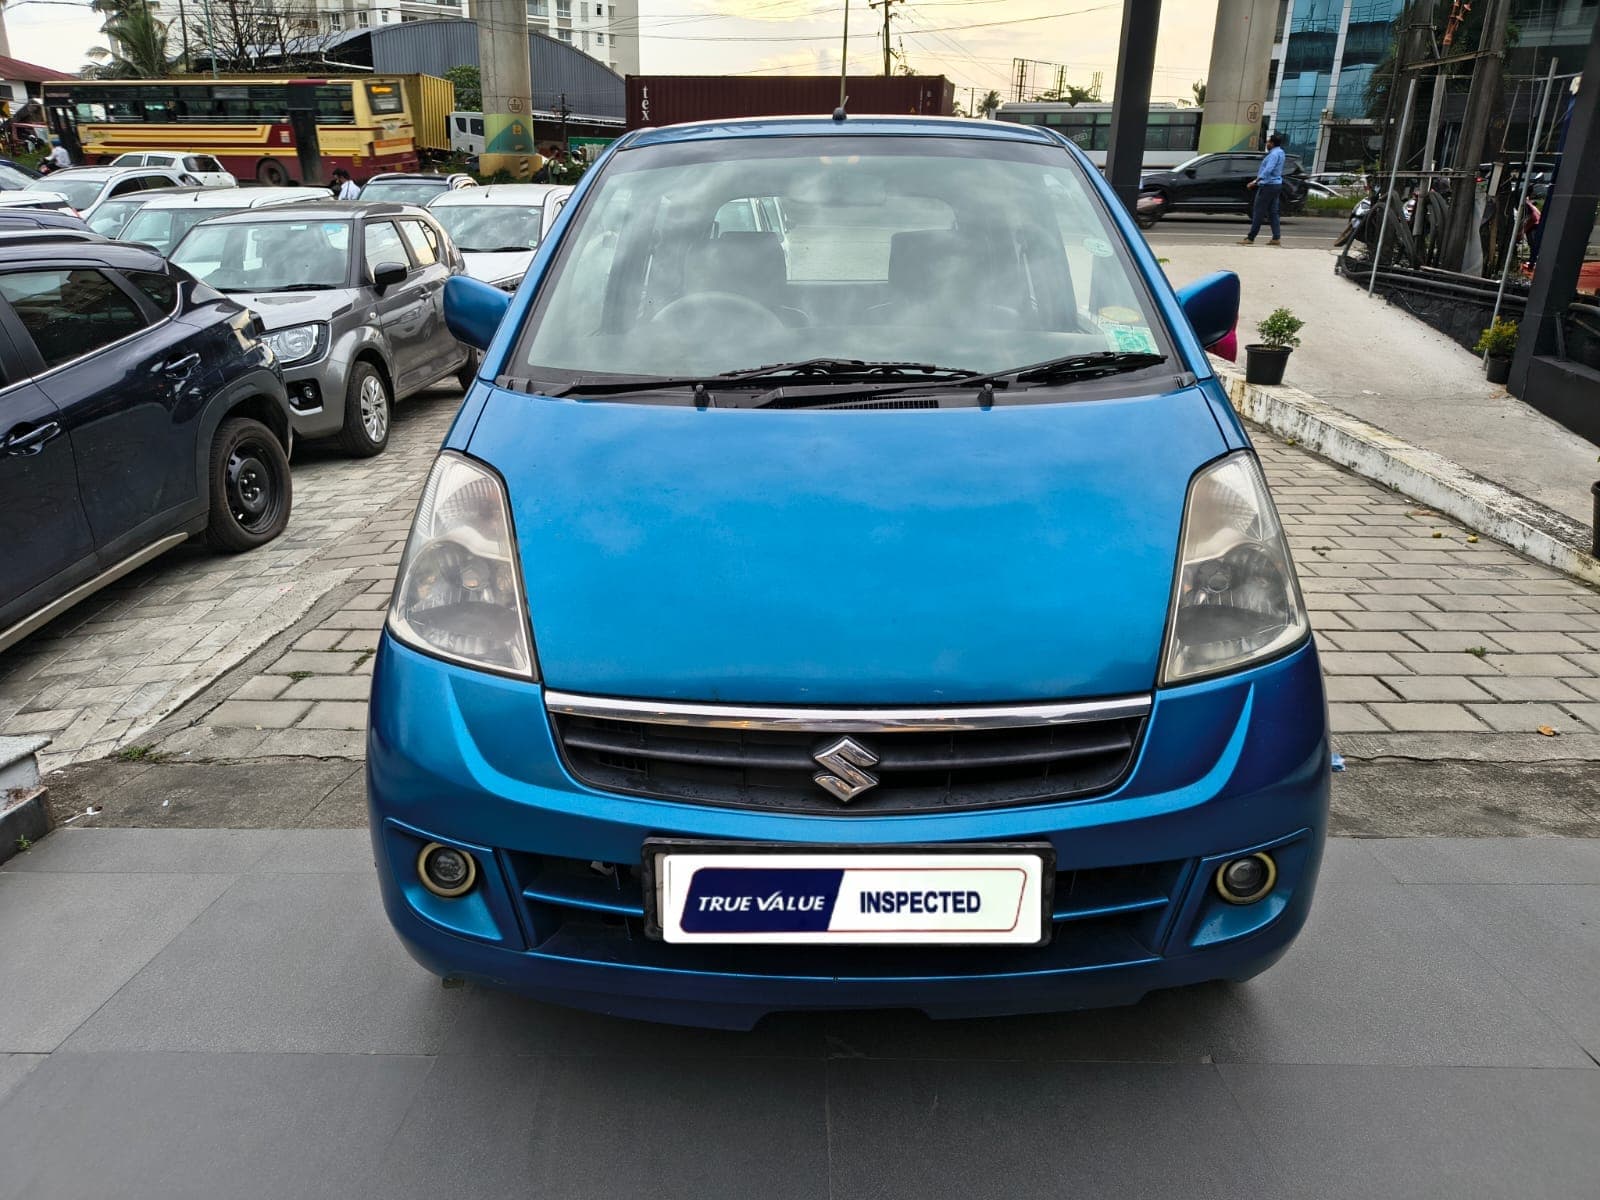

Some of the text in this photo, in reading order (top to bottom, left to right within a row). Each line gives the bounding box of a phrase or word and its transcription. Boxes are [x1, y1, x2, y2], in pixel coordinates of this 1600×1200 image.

[641, 85, 650, 121] tex
[698, 890, 982, 914] TRUE VALUE INSPECTED
